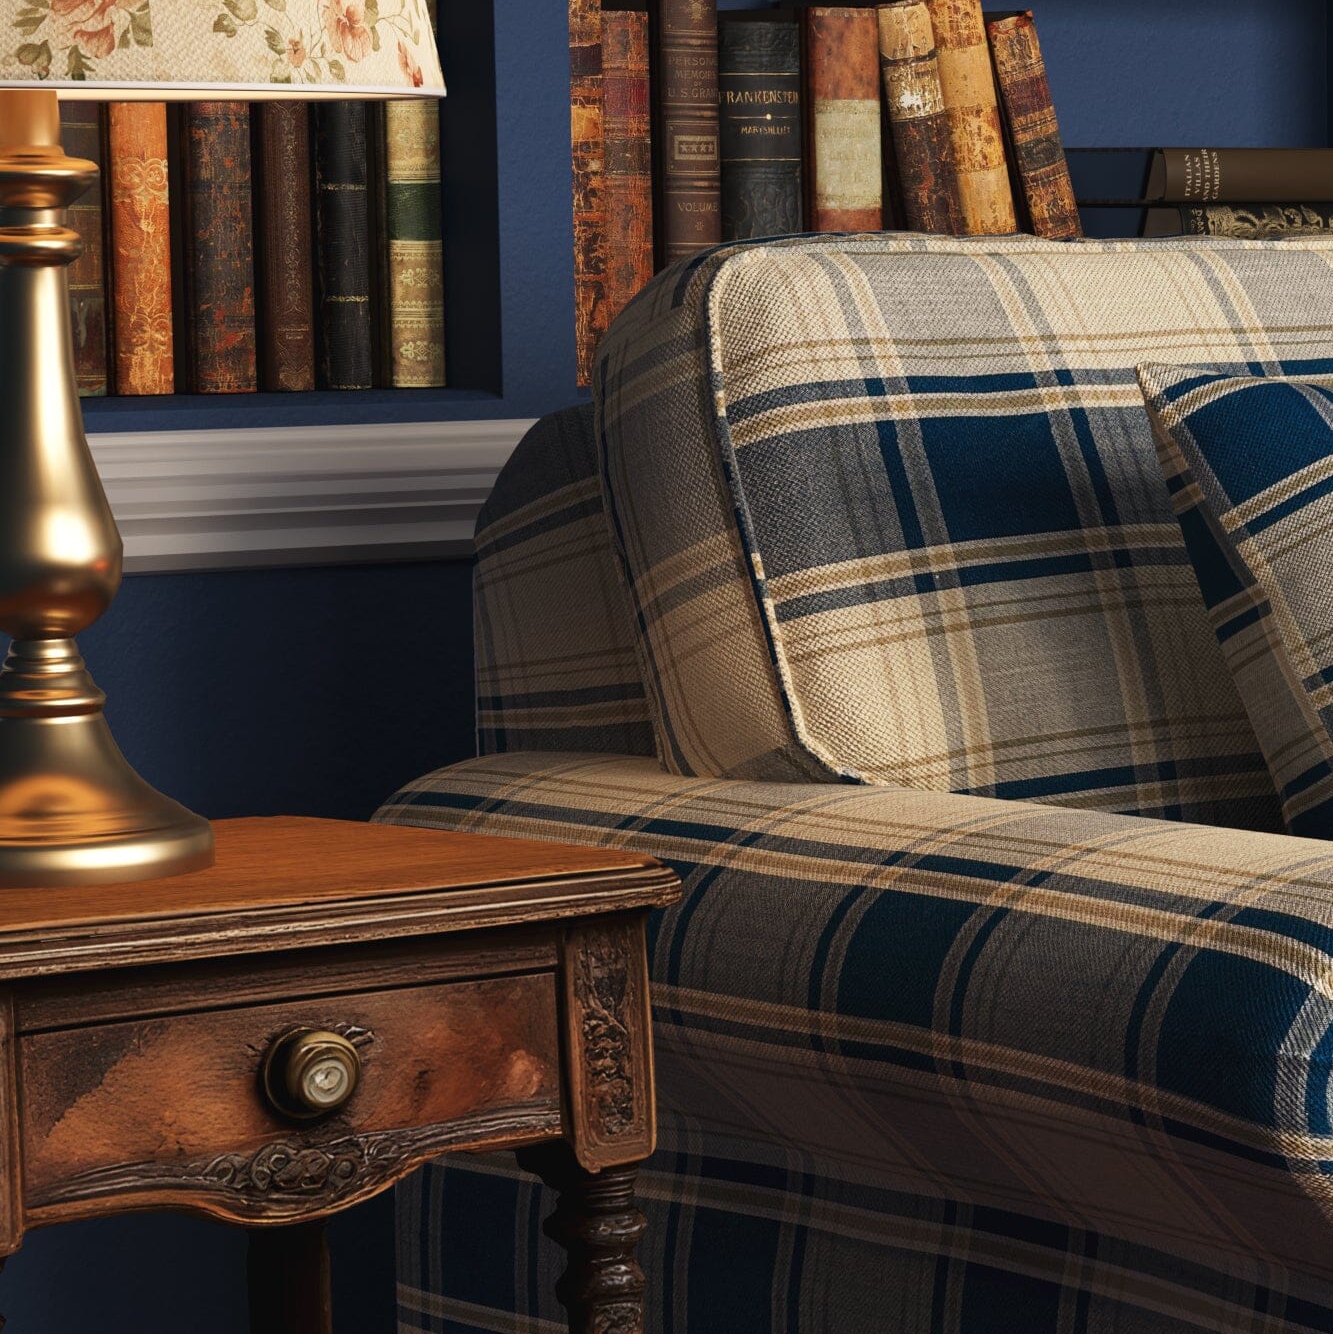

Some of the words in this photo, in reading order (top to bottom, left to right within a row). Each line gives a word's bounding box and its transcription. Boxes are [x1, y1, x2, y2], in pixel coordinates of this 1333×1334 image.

[1184, 154, 1192, 198] ITALIAN
[1201, 148, 1210, 180] THEIR
[1211, 151, 1219, 201] GARDENS
[677, 201, 719, 213] VOLUME
